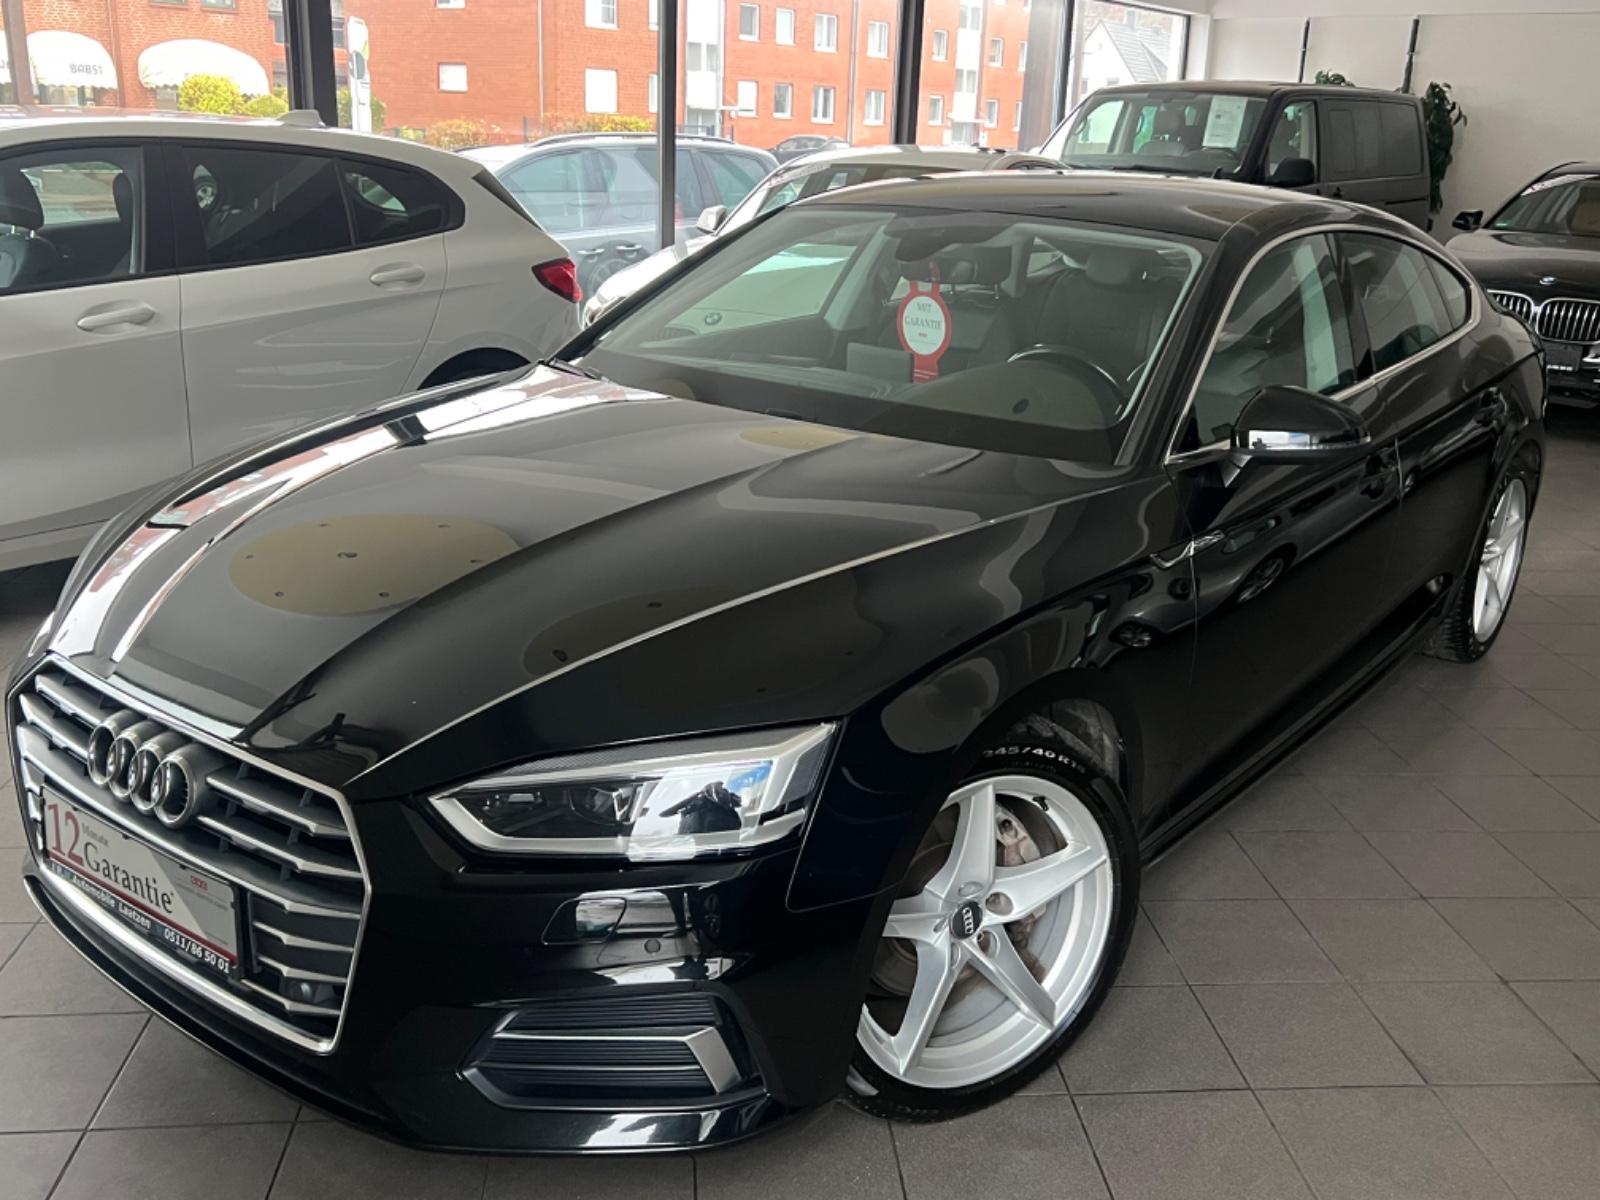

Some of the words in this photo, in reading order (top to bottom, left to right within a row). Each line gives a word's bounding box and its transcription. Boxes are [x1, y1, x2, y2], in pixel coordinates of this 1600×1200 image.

[47, 803, 84, 866] 12
[84, 841, 174, 914] Garantie
[118, 901, 152, 929] Laatzen
[164, 928, 202, 958] 0511/86
[204, 950, 217, 966] 50
[218, 958, 230, 974] 01
